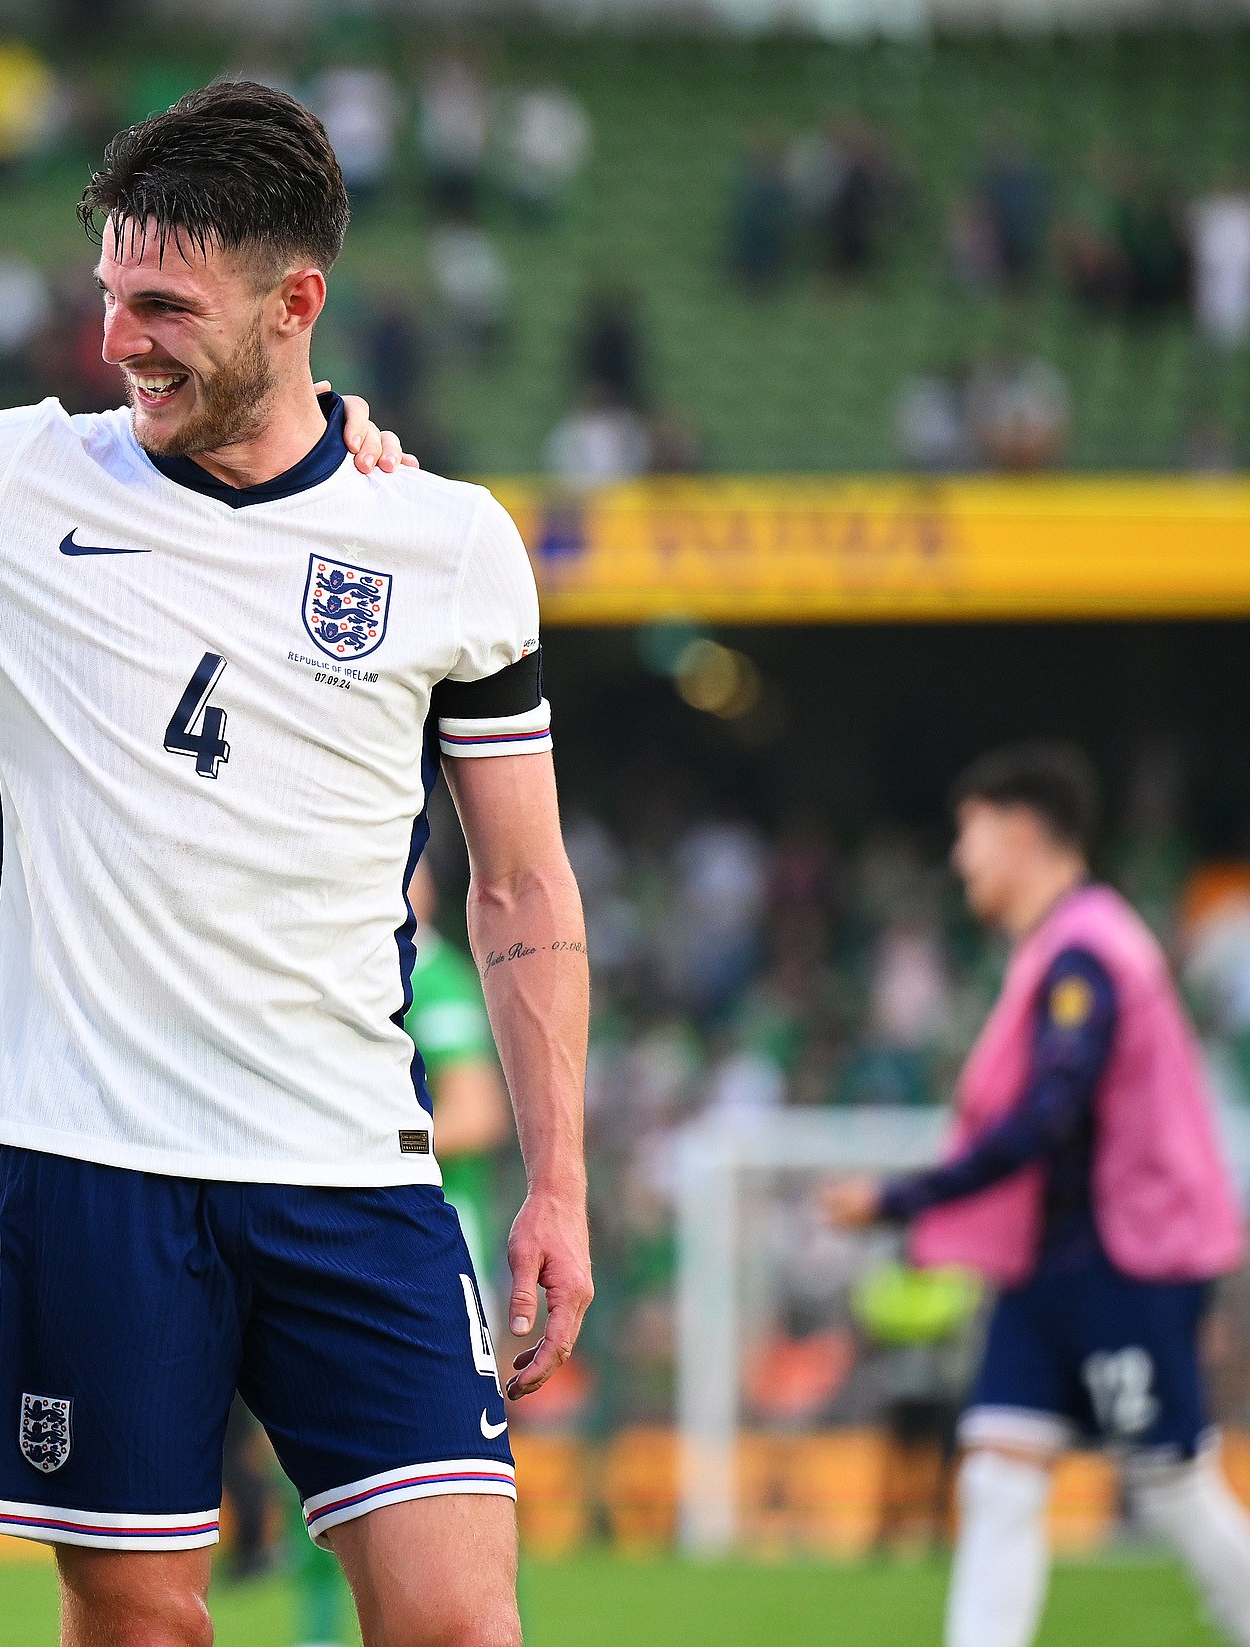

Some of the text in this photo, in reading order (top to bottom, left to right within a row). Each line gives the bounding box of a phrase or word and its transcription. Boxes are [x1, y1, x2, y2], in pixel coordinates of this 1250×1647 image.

[287, 651, 380, 684] REPUBLIC OF IRELAND
[314, 672, 351, 690] 07.09.24
[163, 651, 231, 780] 4
